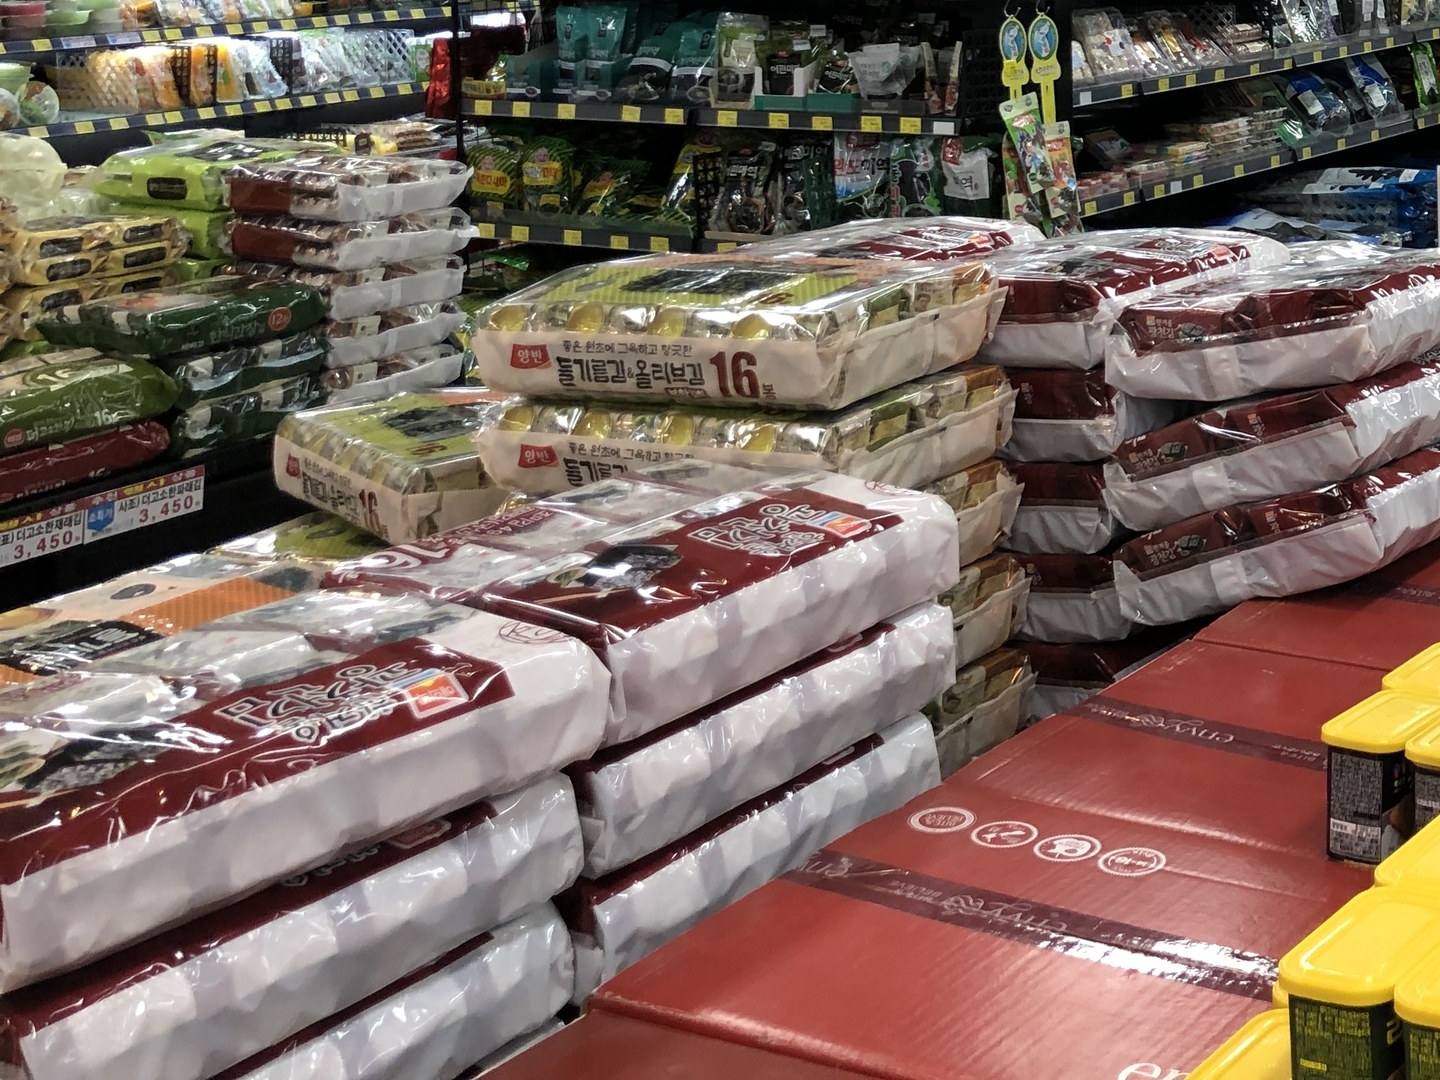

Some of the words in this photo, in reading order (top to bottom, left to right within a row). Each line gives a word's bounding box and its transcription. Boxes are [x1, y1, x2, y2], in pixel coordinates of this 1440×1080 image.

[517, 349, 543, 364] 양반
[138, 495, 193, 523] 3,450
[14, 530, 73, 560] 3,450
